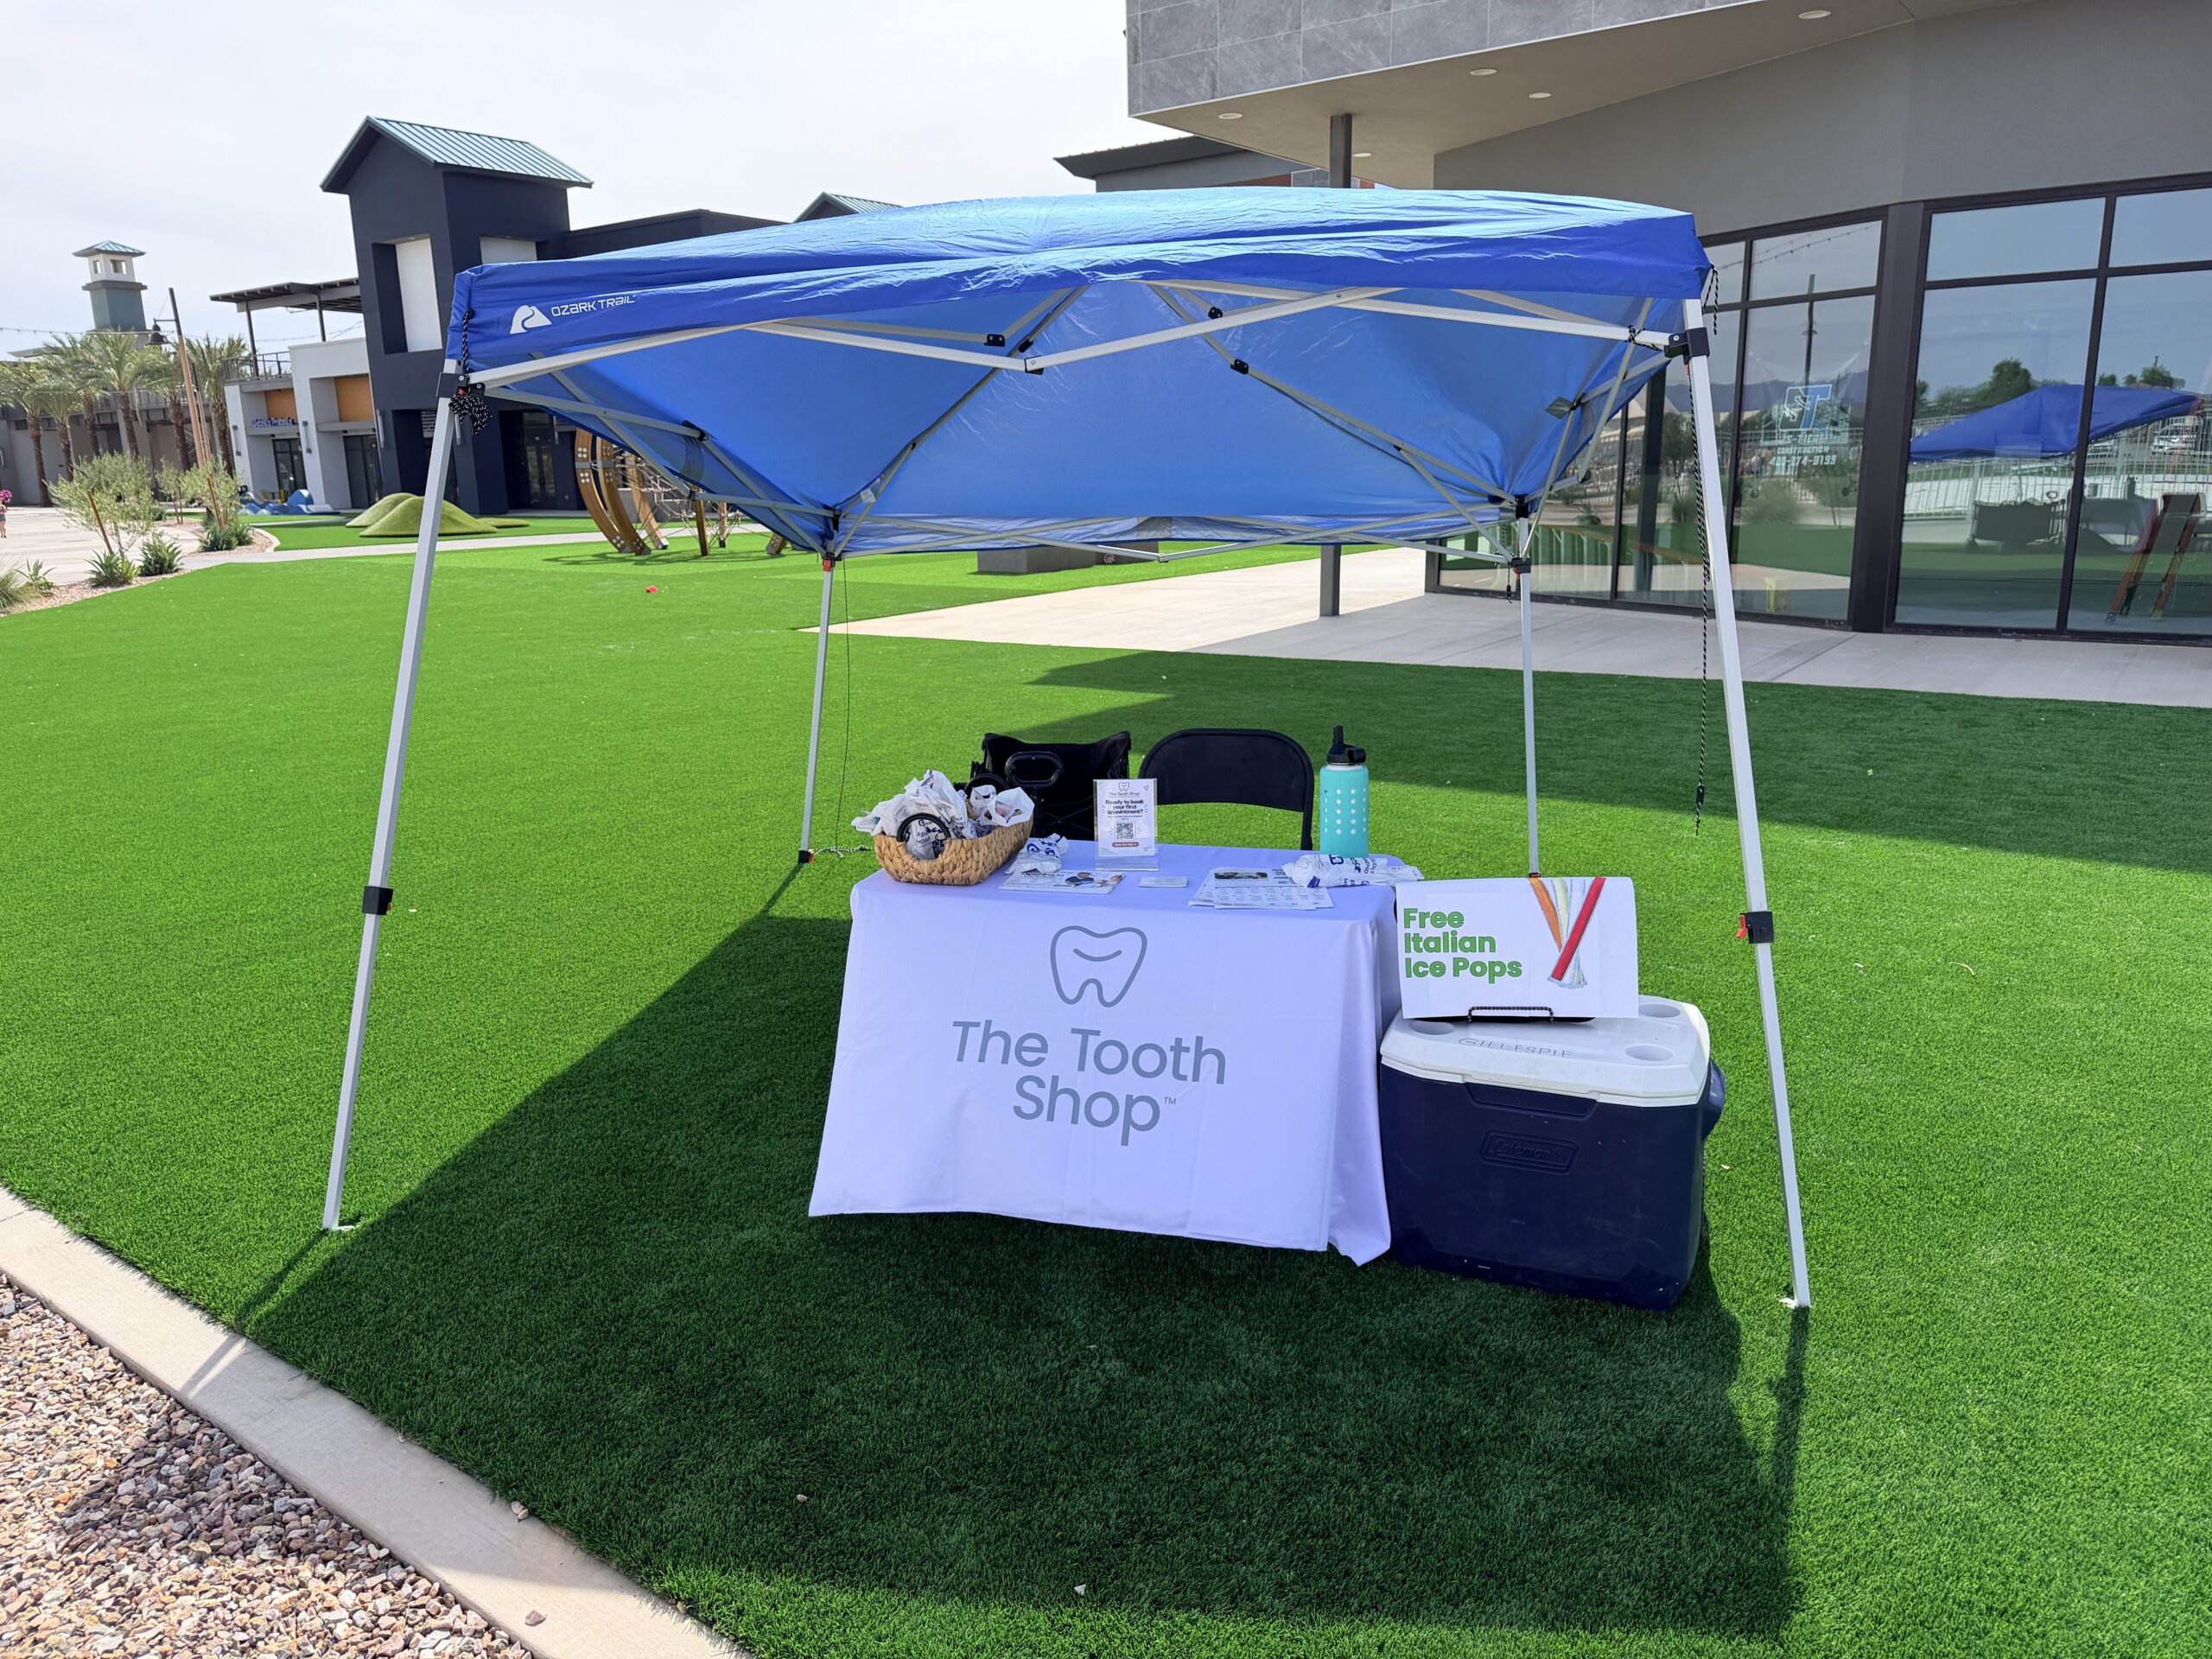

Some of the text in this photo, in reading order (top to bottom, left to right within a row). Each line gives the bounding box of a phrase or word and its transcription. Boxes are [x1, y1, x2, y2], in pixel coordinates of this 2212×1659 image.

[550, 295, 635, 317] OZARK TRAIL
[1777, 445, 1830, 454] CONSTRUCTION
[1785, 435, 1820, 444] S-TIER
[1403, 907, 1465, 929] Free
[1404, 930, 1497, 954] Italian
[1405, 957, 1522, 984] Ice Pops
[952, 1020, 1226, 1085] The Tooth
[1458, 1037, 1574, 1058] GILLESPIE
[1013, 1075, 1160, 1147] Shop
[1495, 1138, 1551, 1161] Coleman
